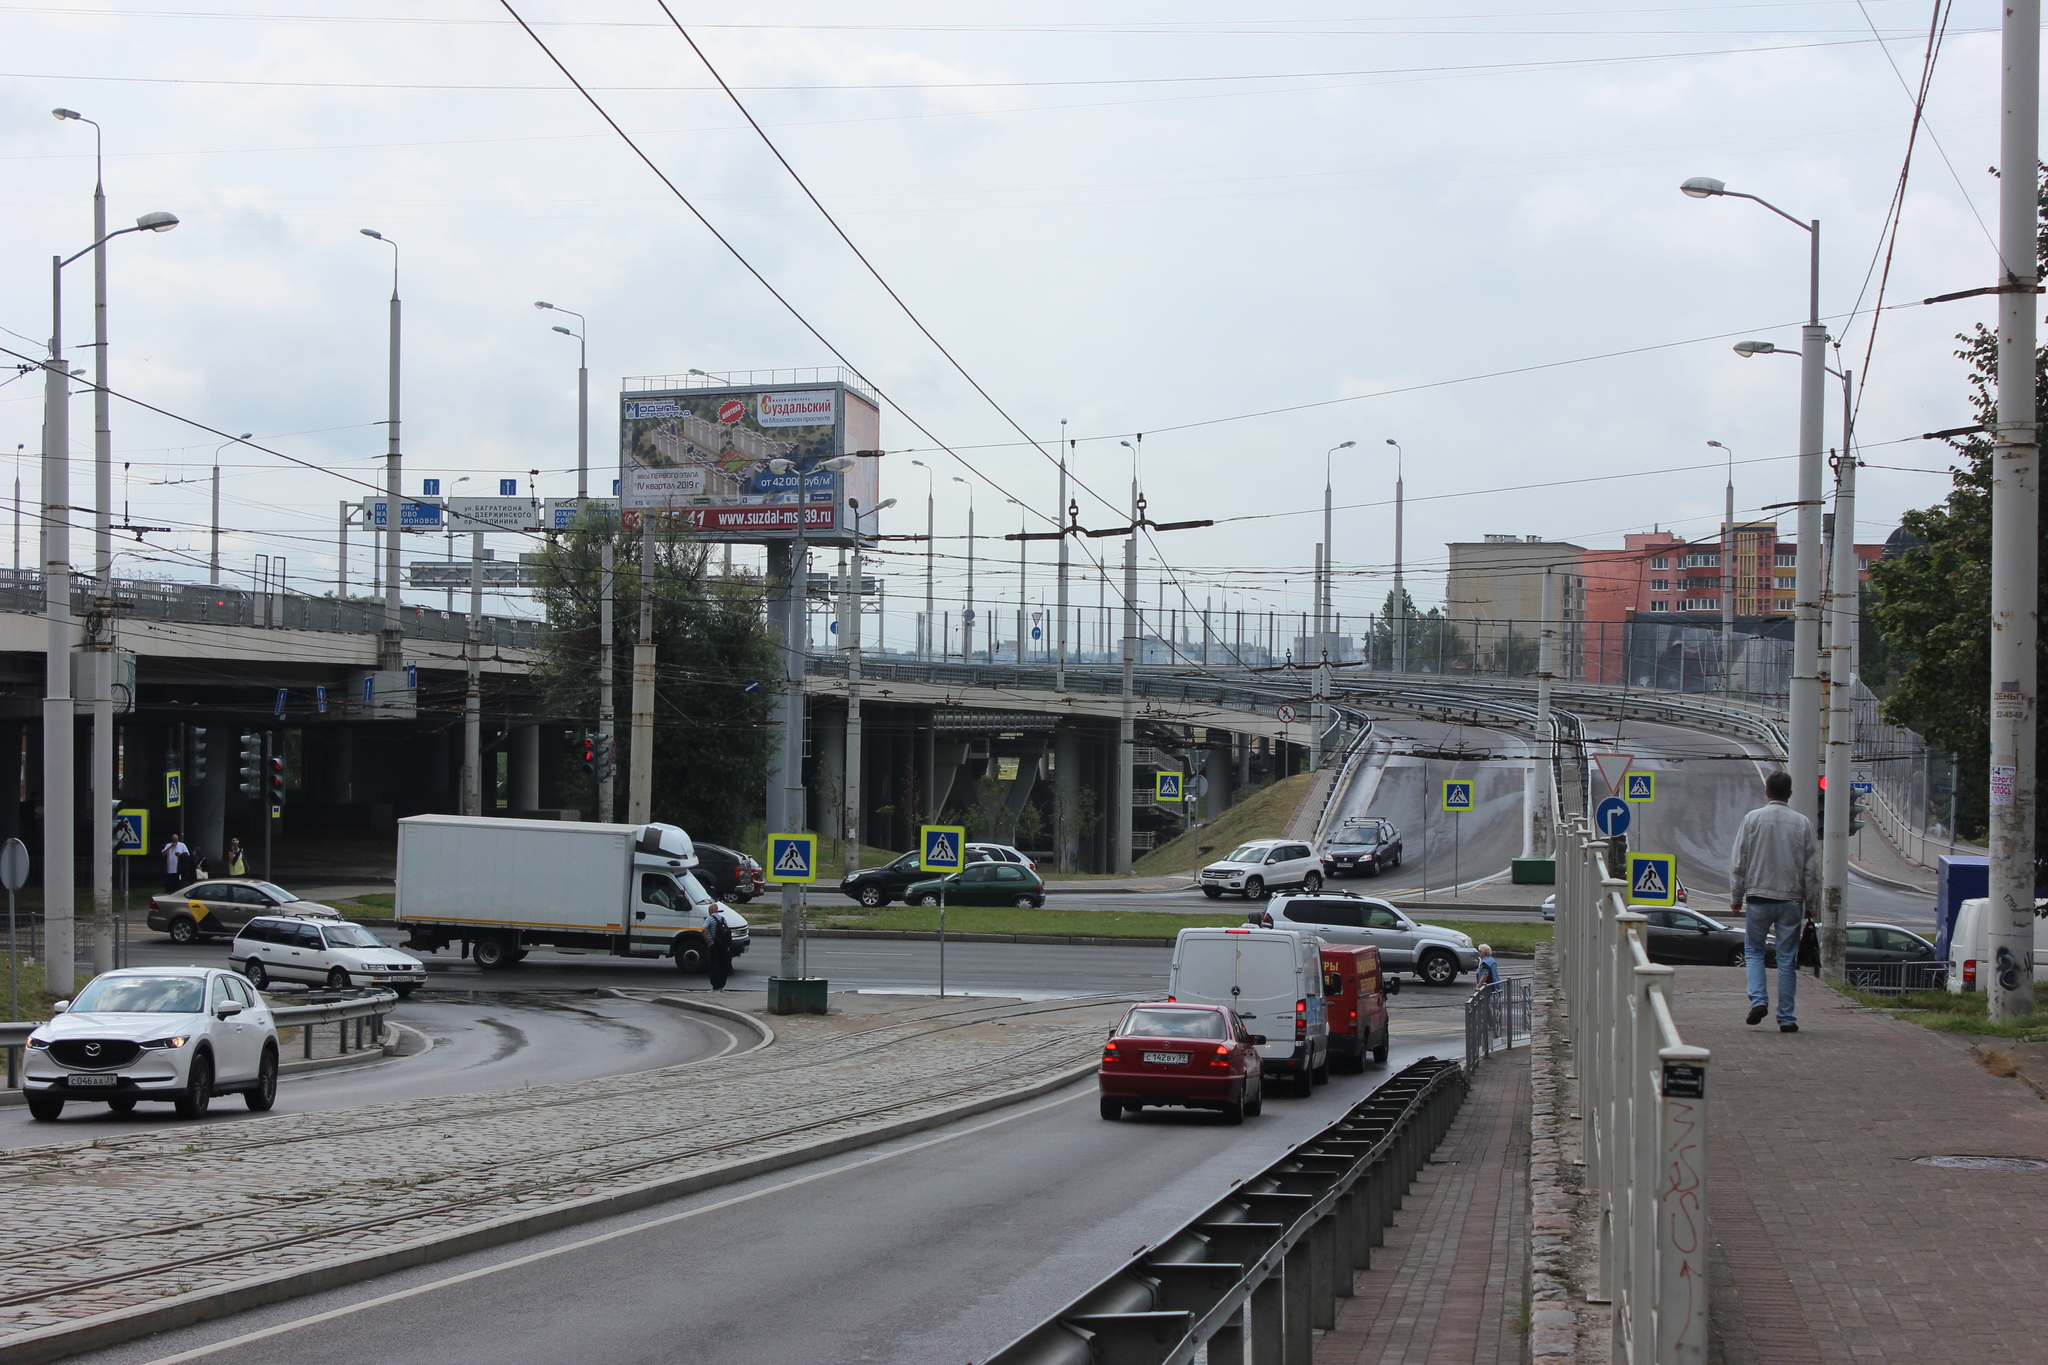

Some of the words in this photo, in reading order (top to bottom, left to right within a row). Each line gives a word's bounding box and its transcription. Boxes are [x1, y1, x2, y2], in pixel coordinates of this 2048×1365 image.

[760, 395, 831, 416] Суздальский
[680, 471, 699, 479] ЭТАПА
[677, 481, 694, 490] 2019
[773, 478, 785, 486] 42
[718, 509, 831, 525] www.suzdal-ms39.ru
